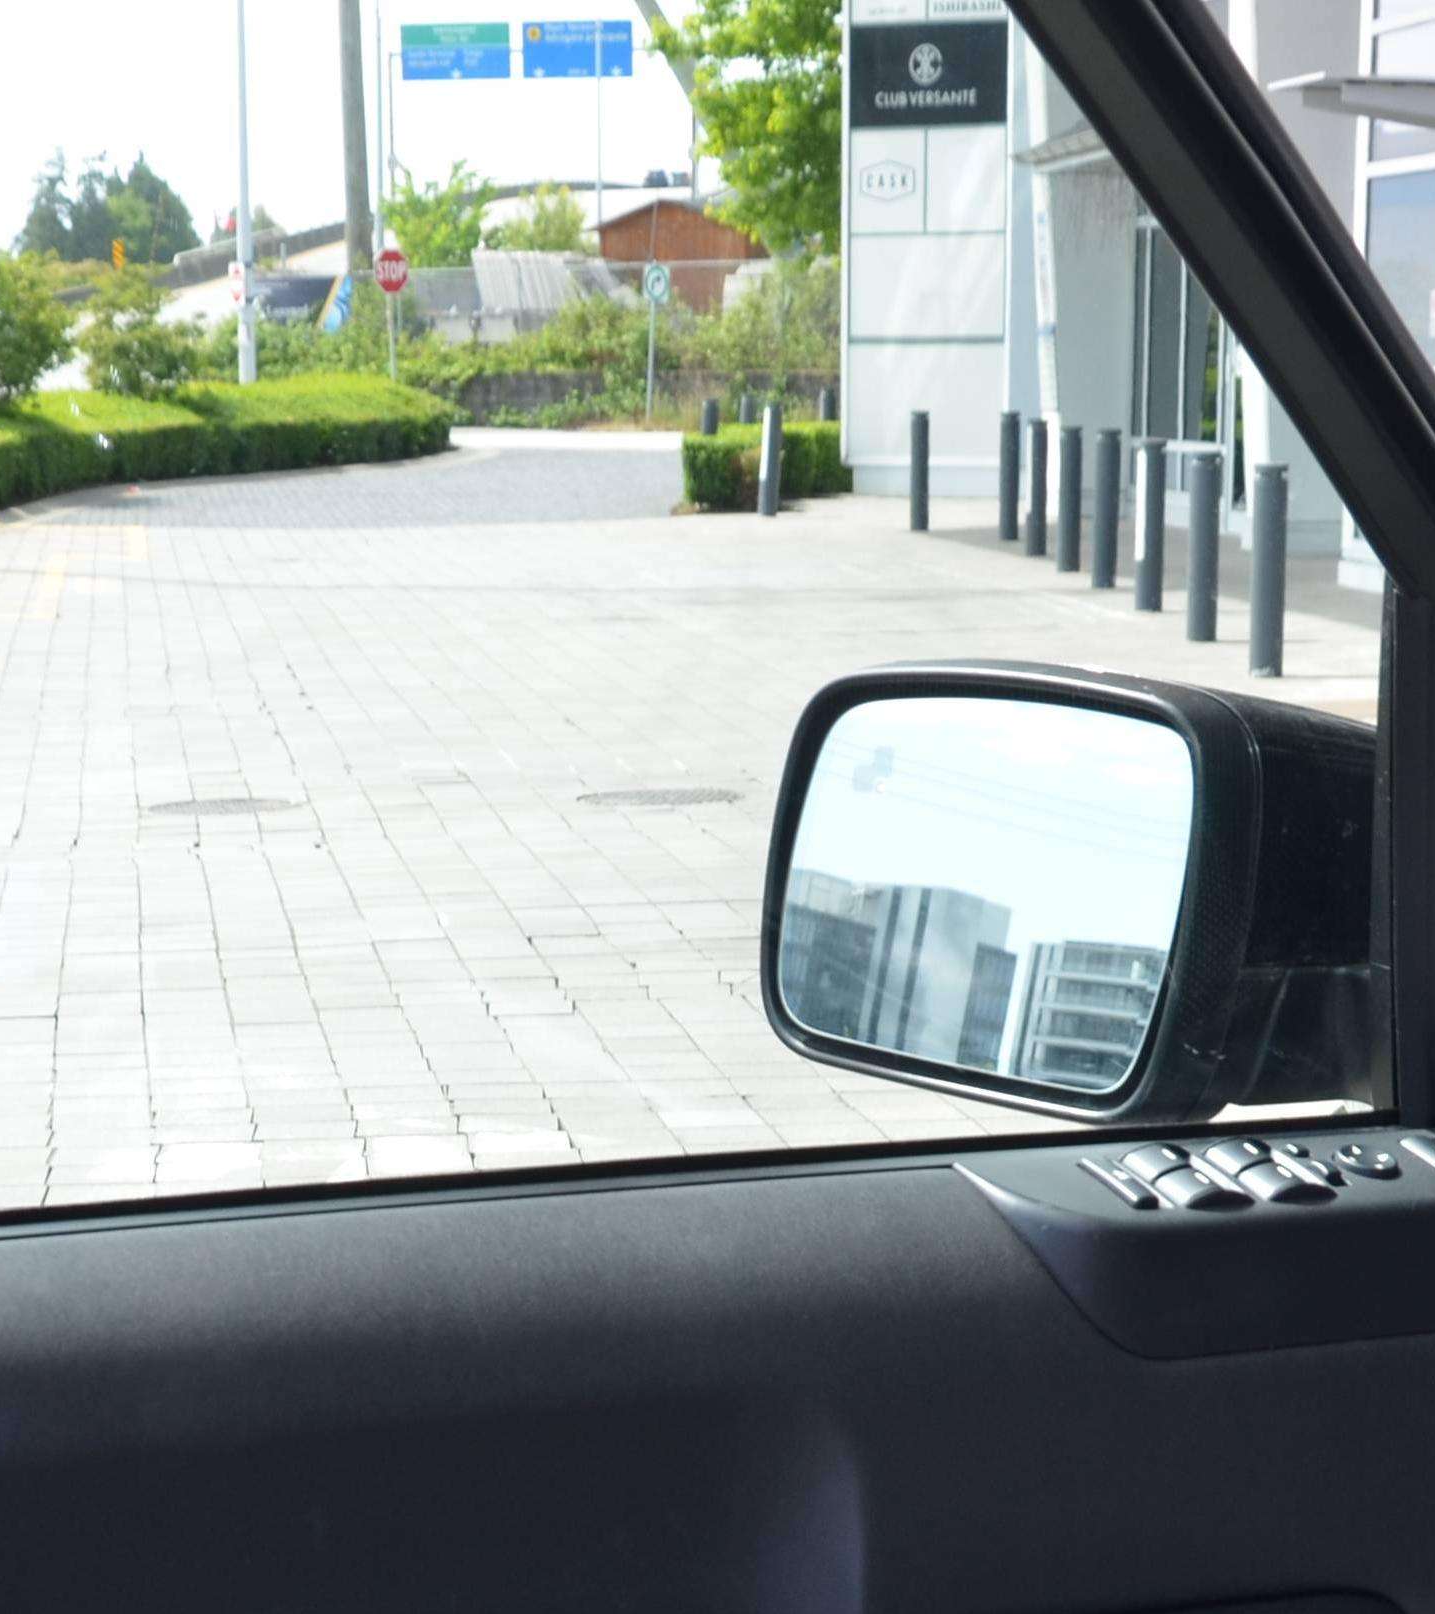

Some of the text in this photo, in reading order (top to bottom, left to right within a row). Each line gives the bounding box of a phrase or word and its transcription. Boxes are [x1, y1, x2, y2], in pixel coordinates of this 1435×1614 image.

[874, 91, 908, 109] CLUB
[866, 172, 908, 190] CASK
[377, 260, 407, 280] STOP
